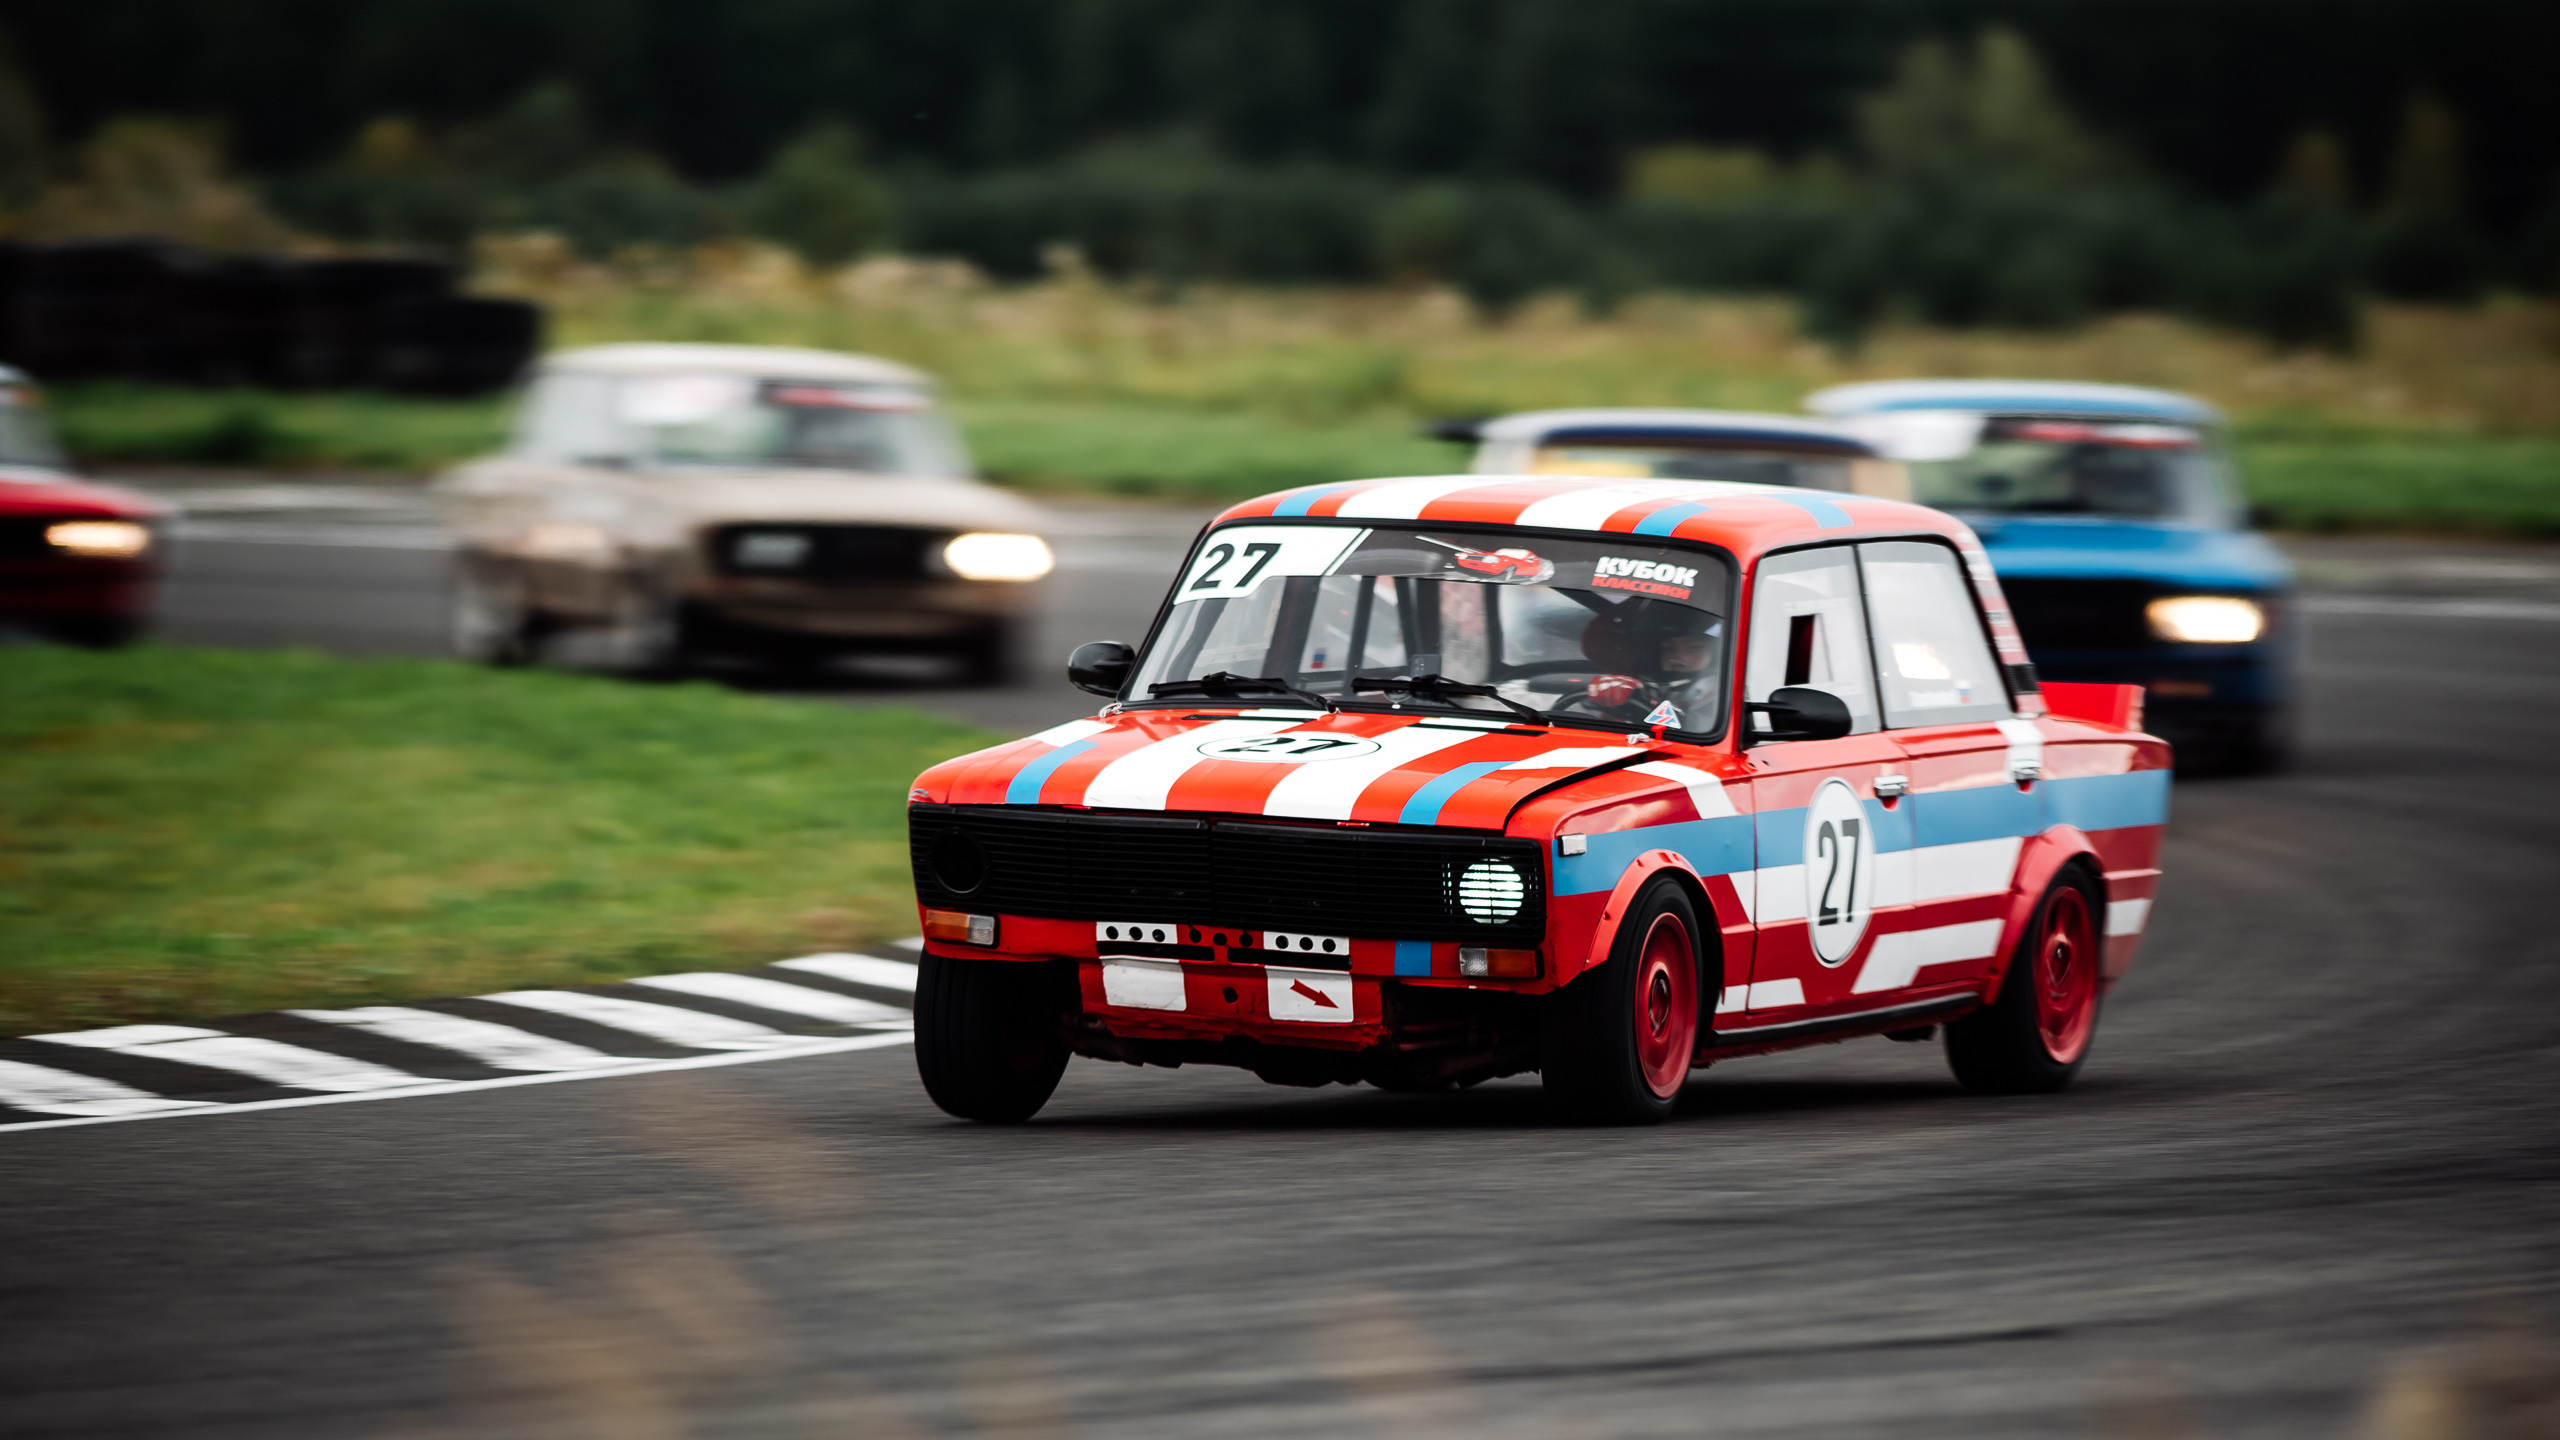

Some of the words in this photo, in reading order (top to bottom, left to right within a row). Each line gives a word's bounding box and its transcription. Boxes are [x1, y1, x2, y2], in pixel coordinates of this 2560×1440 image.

[1189, 543, 1282, 592] 27
[1594, 556, 1699, 587] КУБОК
[1591, 575, 1692, 600] КЛАССИКИ
[1217, 737, 1360, 755] 27
[1818, 818, 1860, 926] 27
